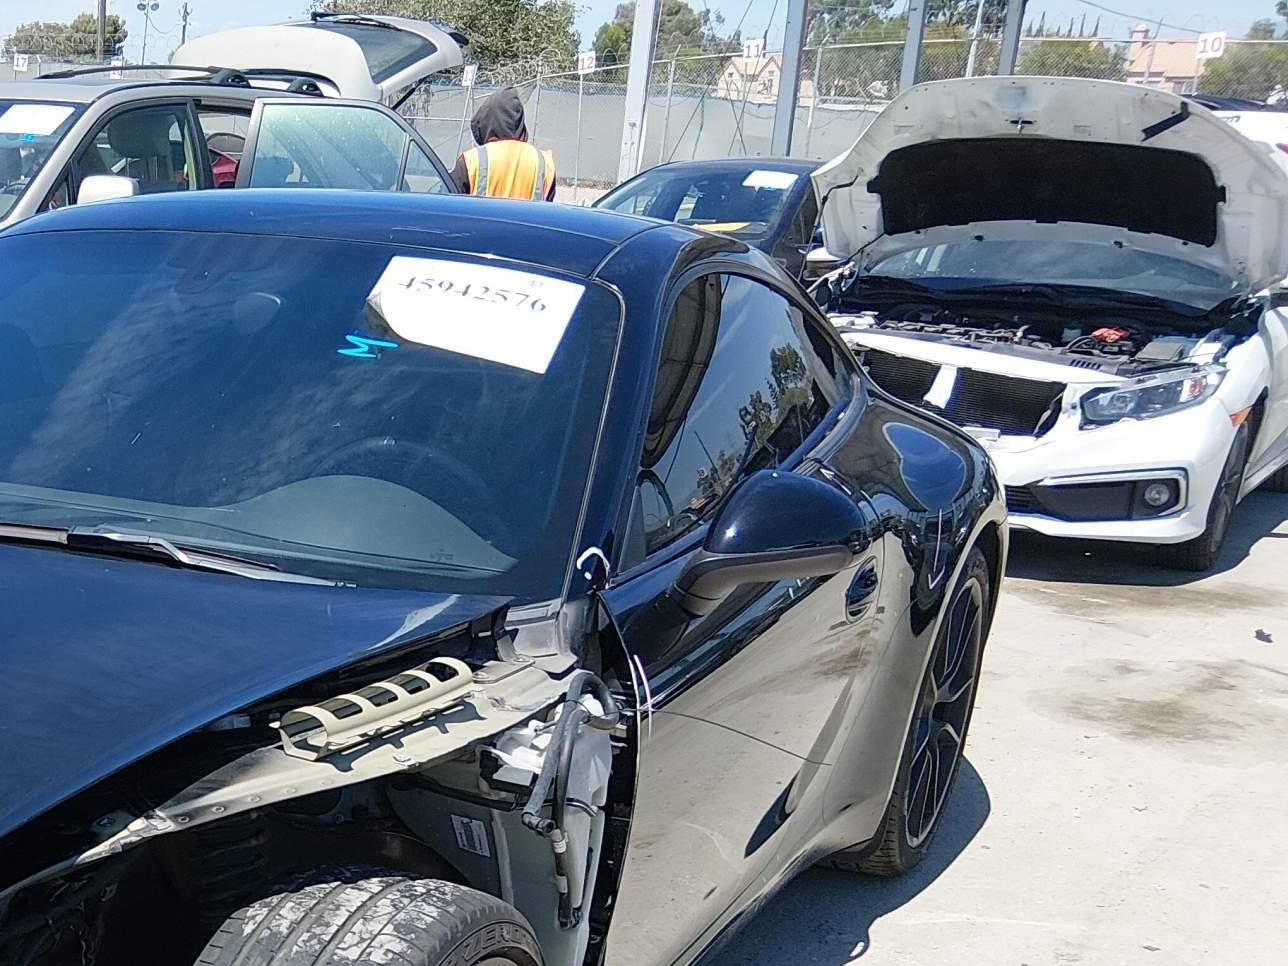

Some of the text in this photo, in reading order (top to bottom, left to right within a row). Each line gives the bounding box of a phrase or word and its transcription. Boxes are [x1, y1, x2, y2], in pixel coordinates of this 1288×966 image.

[745, 44, 761, 58] 11
[1199, 37, 1223, 54] 10
[579, 56, 594, 70] 12
[399, 276, 546, 312] 45942576
